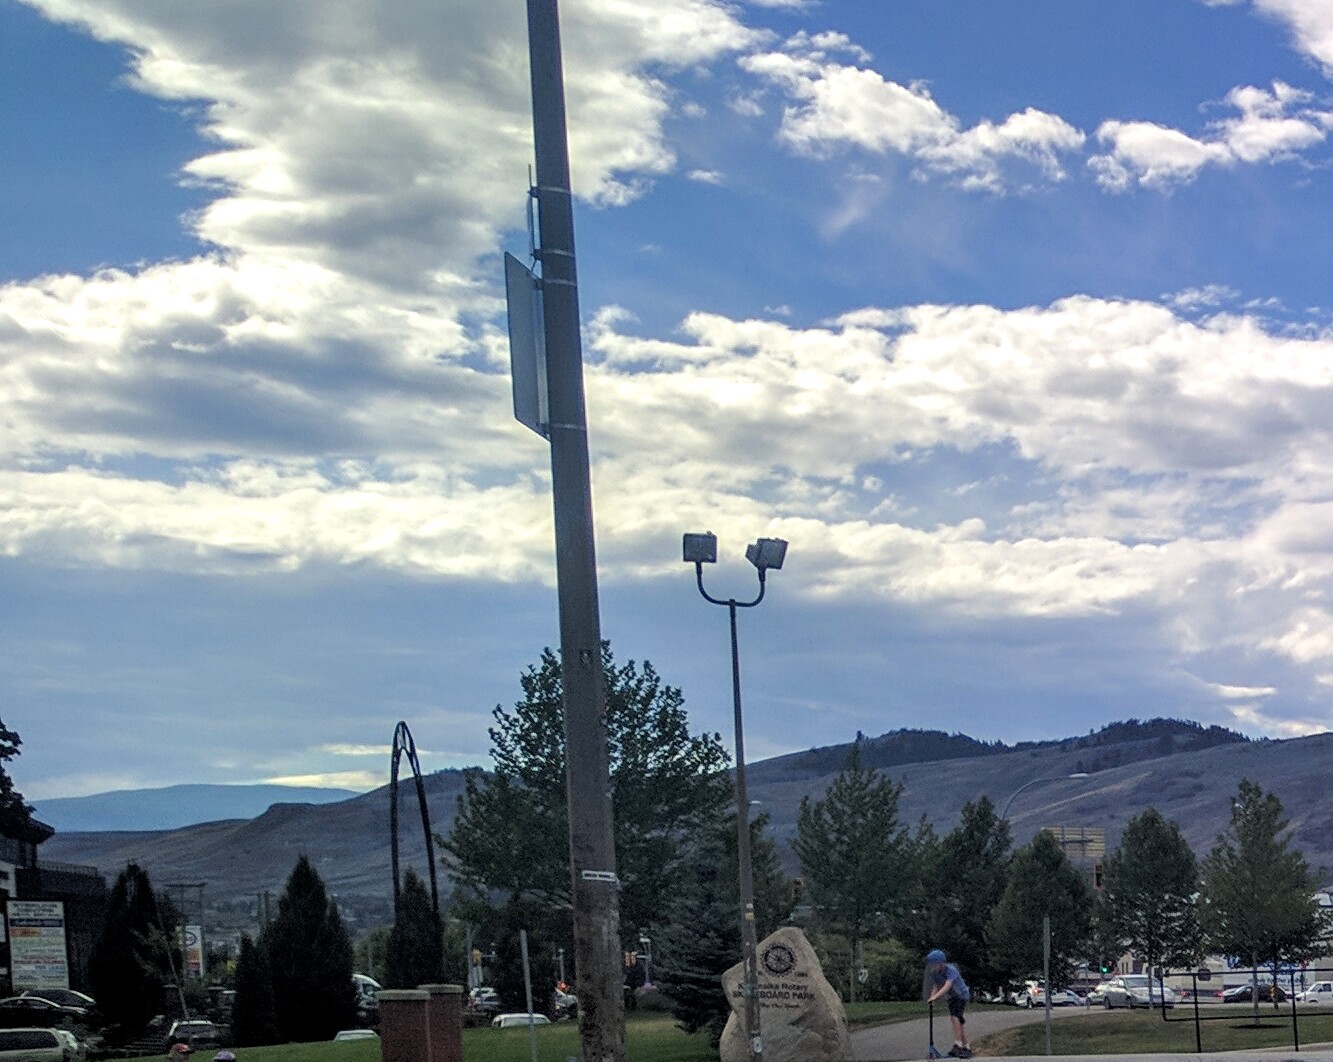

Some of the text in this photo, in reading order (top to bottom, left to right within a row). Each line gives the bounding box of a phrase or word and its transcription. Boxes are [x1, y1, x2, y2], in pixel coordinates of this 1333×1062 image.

[781, 983, 808, 991] Rotary
[733, 990, 816, 1000] SKBOARD PARK
